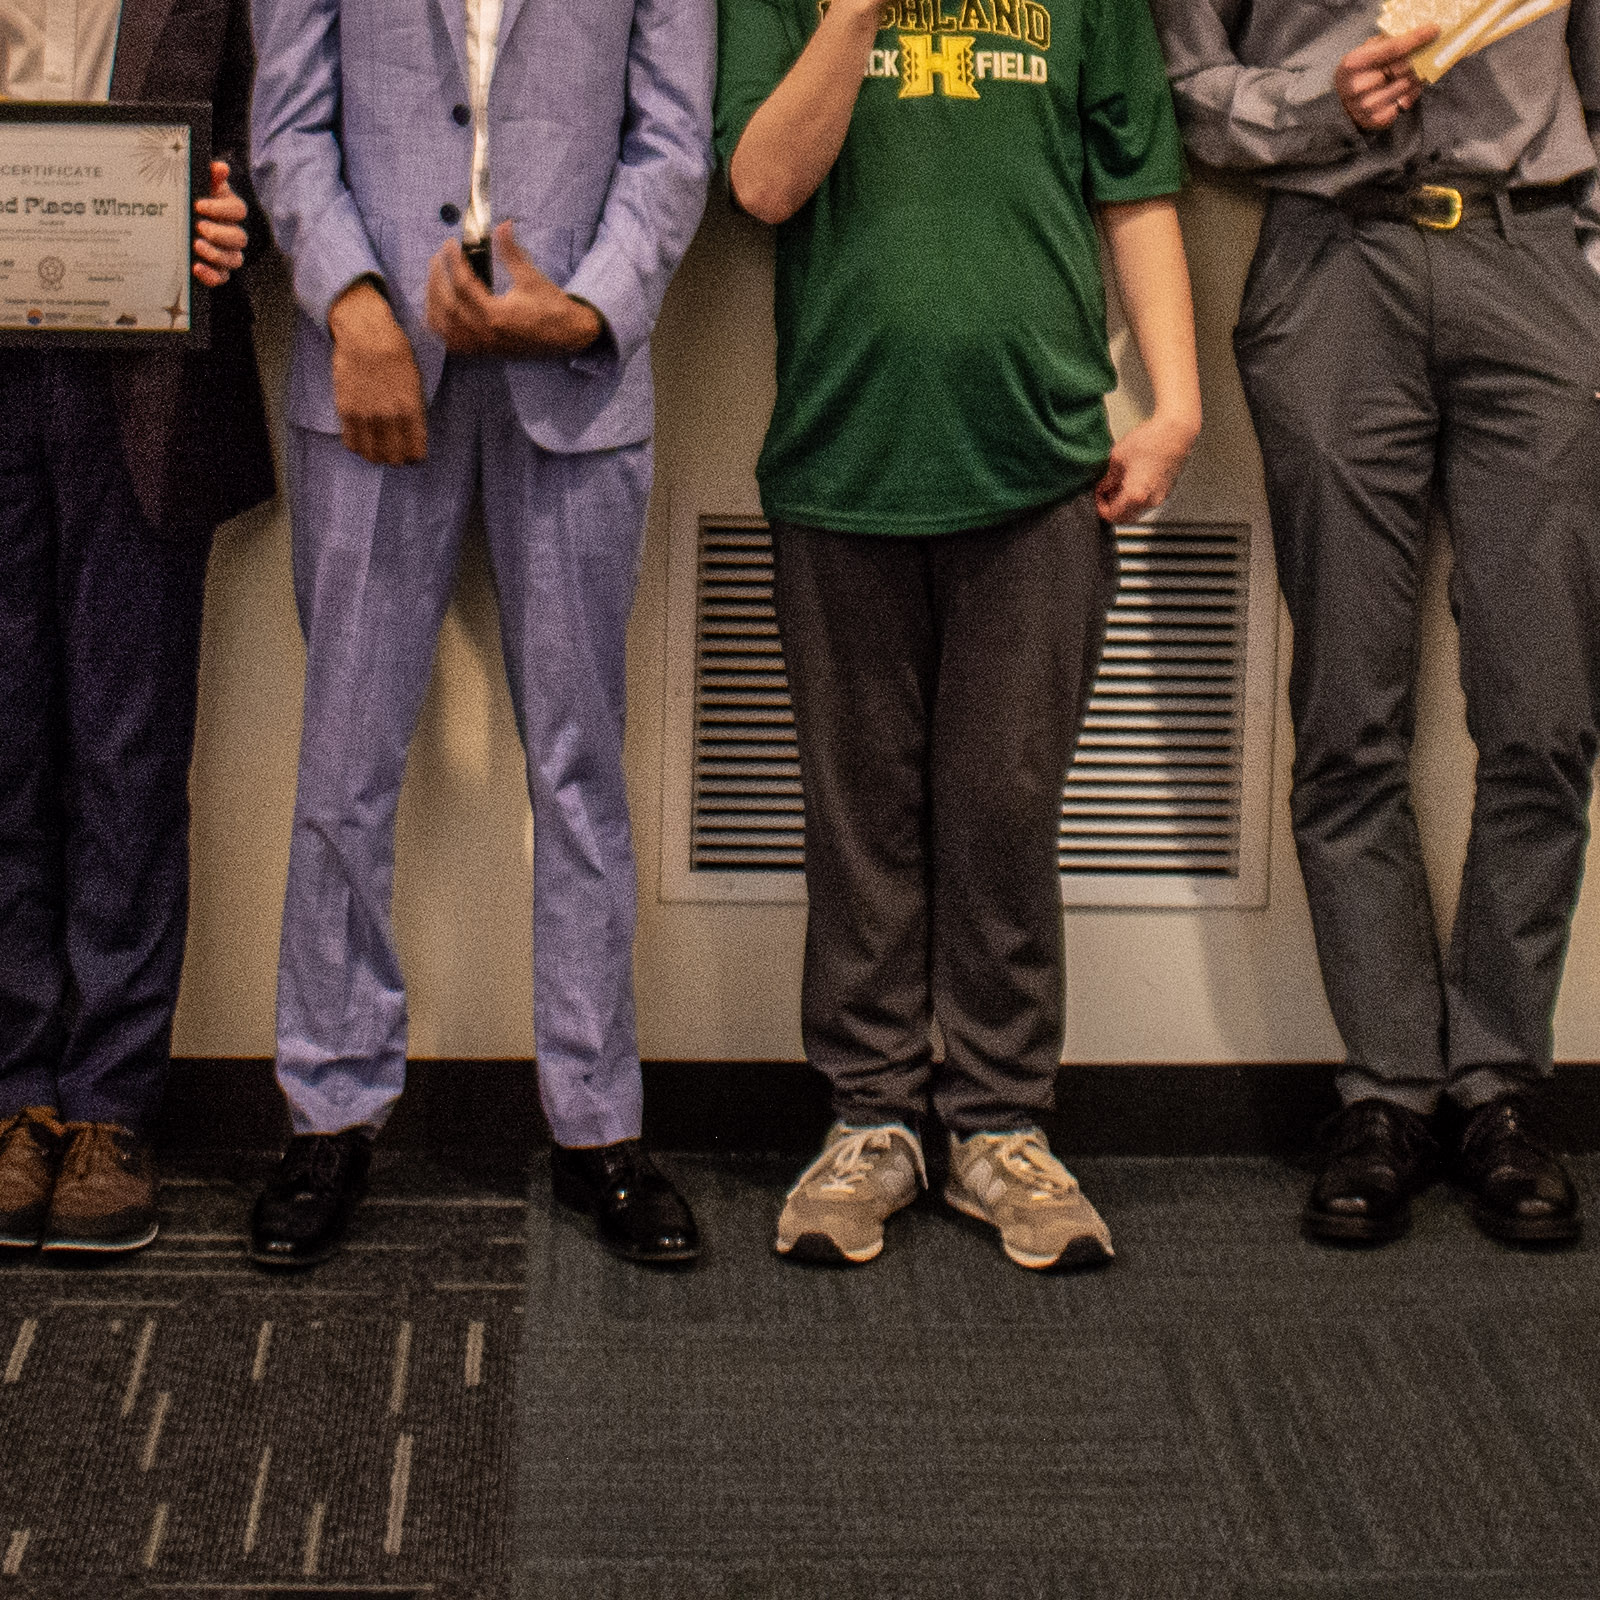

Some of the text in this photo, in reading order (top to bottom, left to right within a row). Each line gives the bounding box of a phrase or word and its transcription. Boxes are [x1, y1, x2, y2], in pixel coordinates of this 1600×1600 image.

[976, 50, 1048, 83] FIELD
[0, 164, 103, 178] CERTIFICATE
[25, 196, 87, 215] Place
[92, 197, 169, 217] Winner
